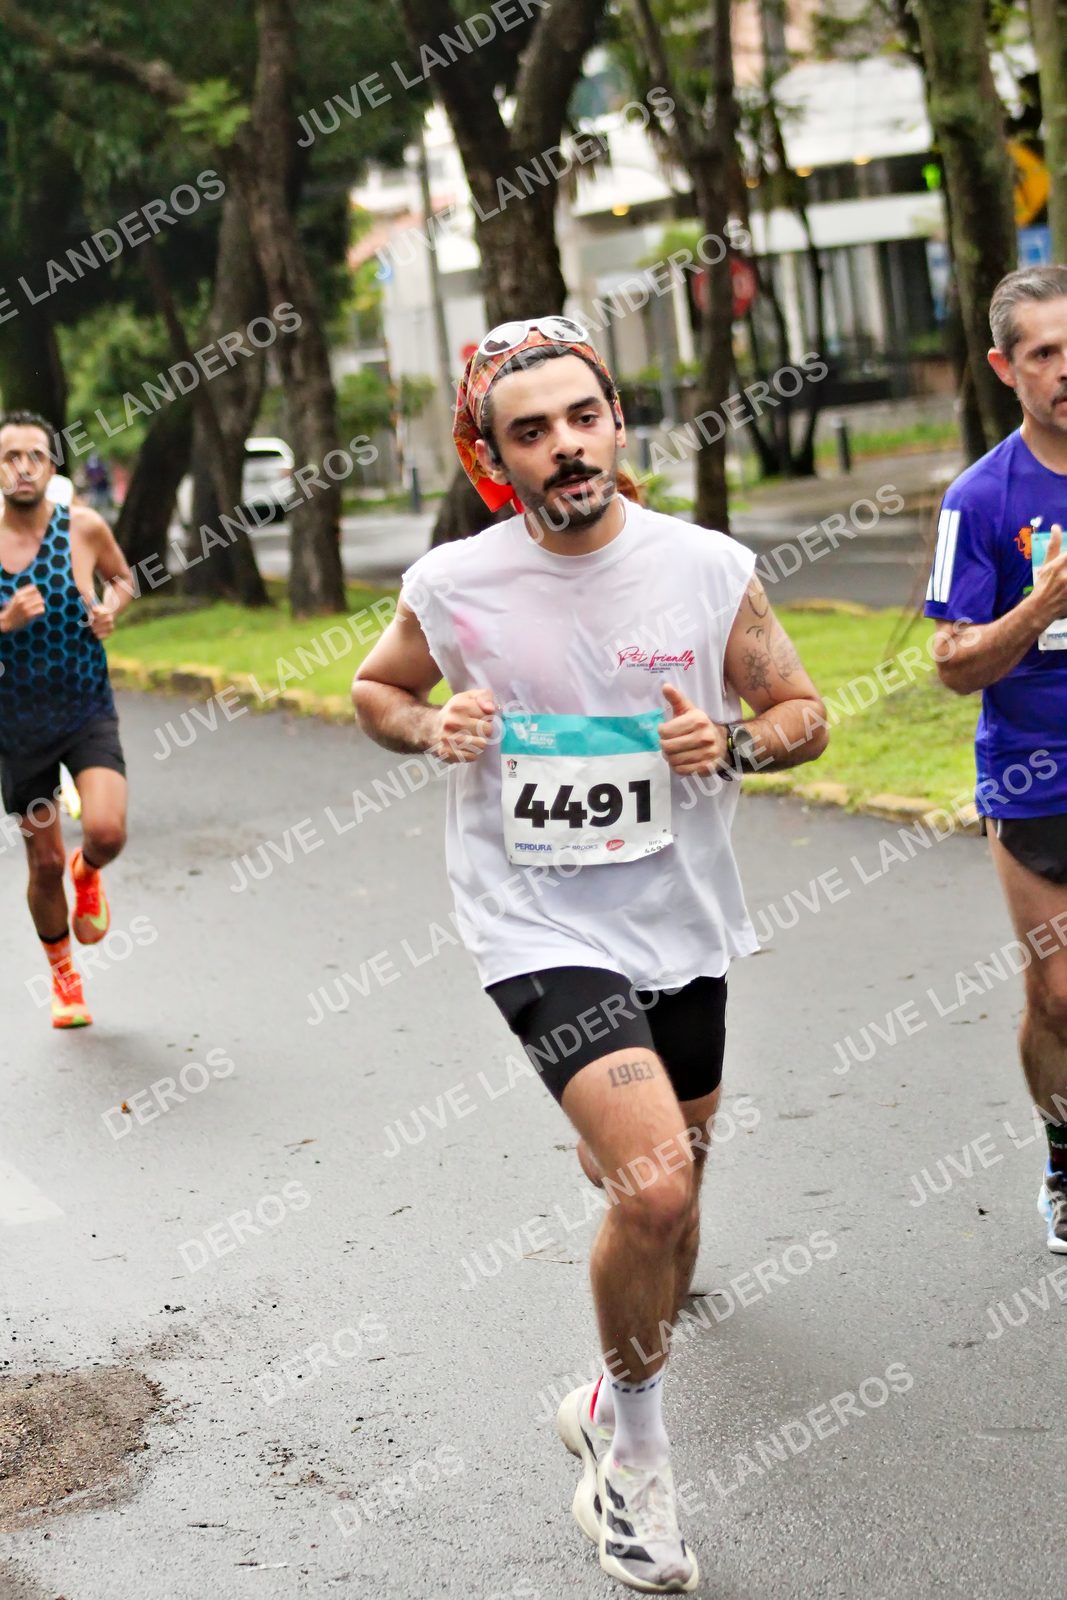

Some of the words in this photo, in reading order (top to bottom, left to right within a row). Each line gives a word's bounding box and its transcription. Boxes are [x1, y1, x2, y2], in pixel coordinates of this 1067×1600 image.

[648, 649, 695, 671] friendly
[514, 780, 651, 829] 4491
[515, 842, 552, 851] PERDURA
[608, 1060, 655, 1088] 1963
